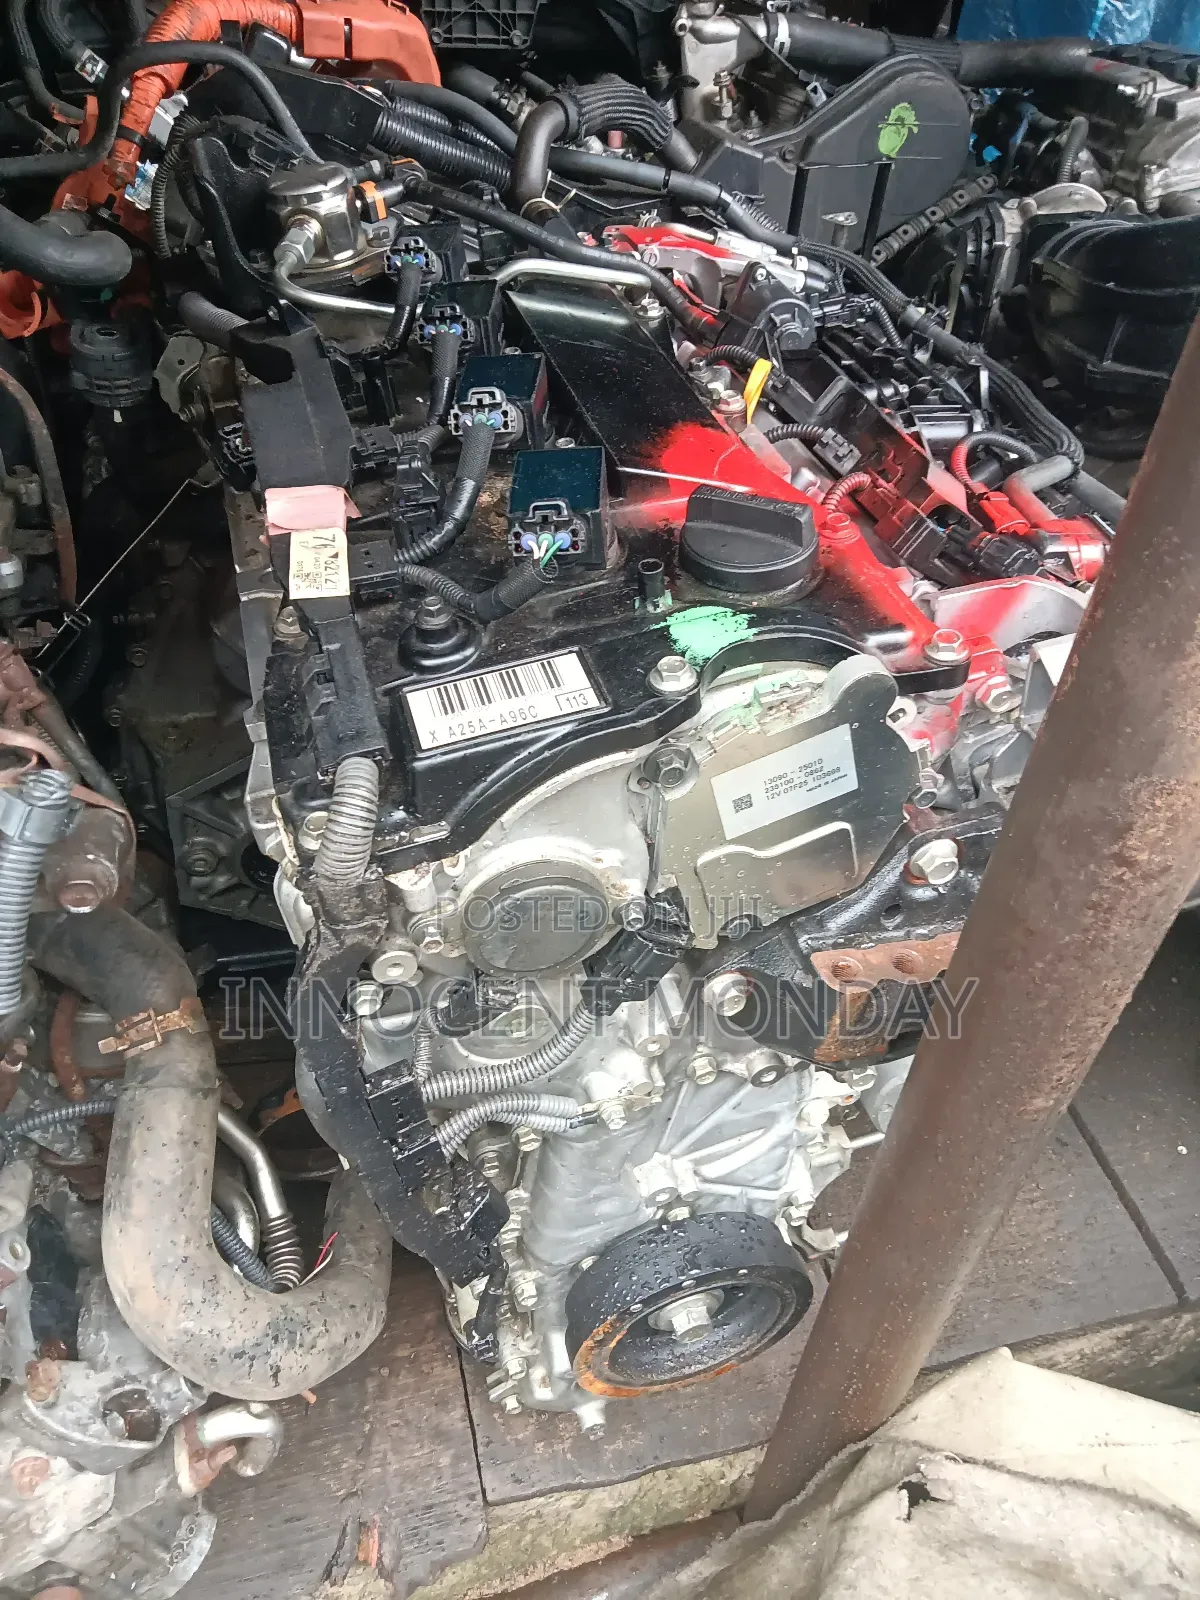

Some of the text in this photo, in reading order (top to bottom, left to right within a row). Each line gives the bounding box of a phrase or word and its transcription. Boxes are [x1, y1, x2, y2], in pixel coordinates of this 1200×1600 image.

[565, 693, 589, 709] 113
[429, 705, 539, 743] X A25A-A96C
